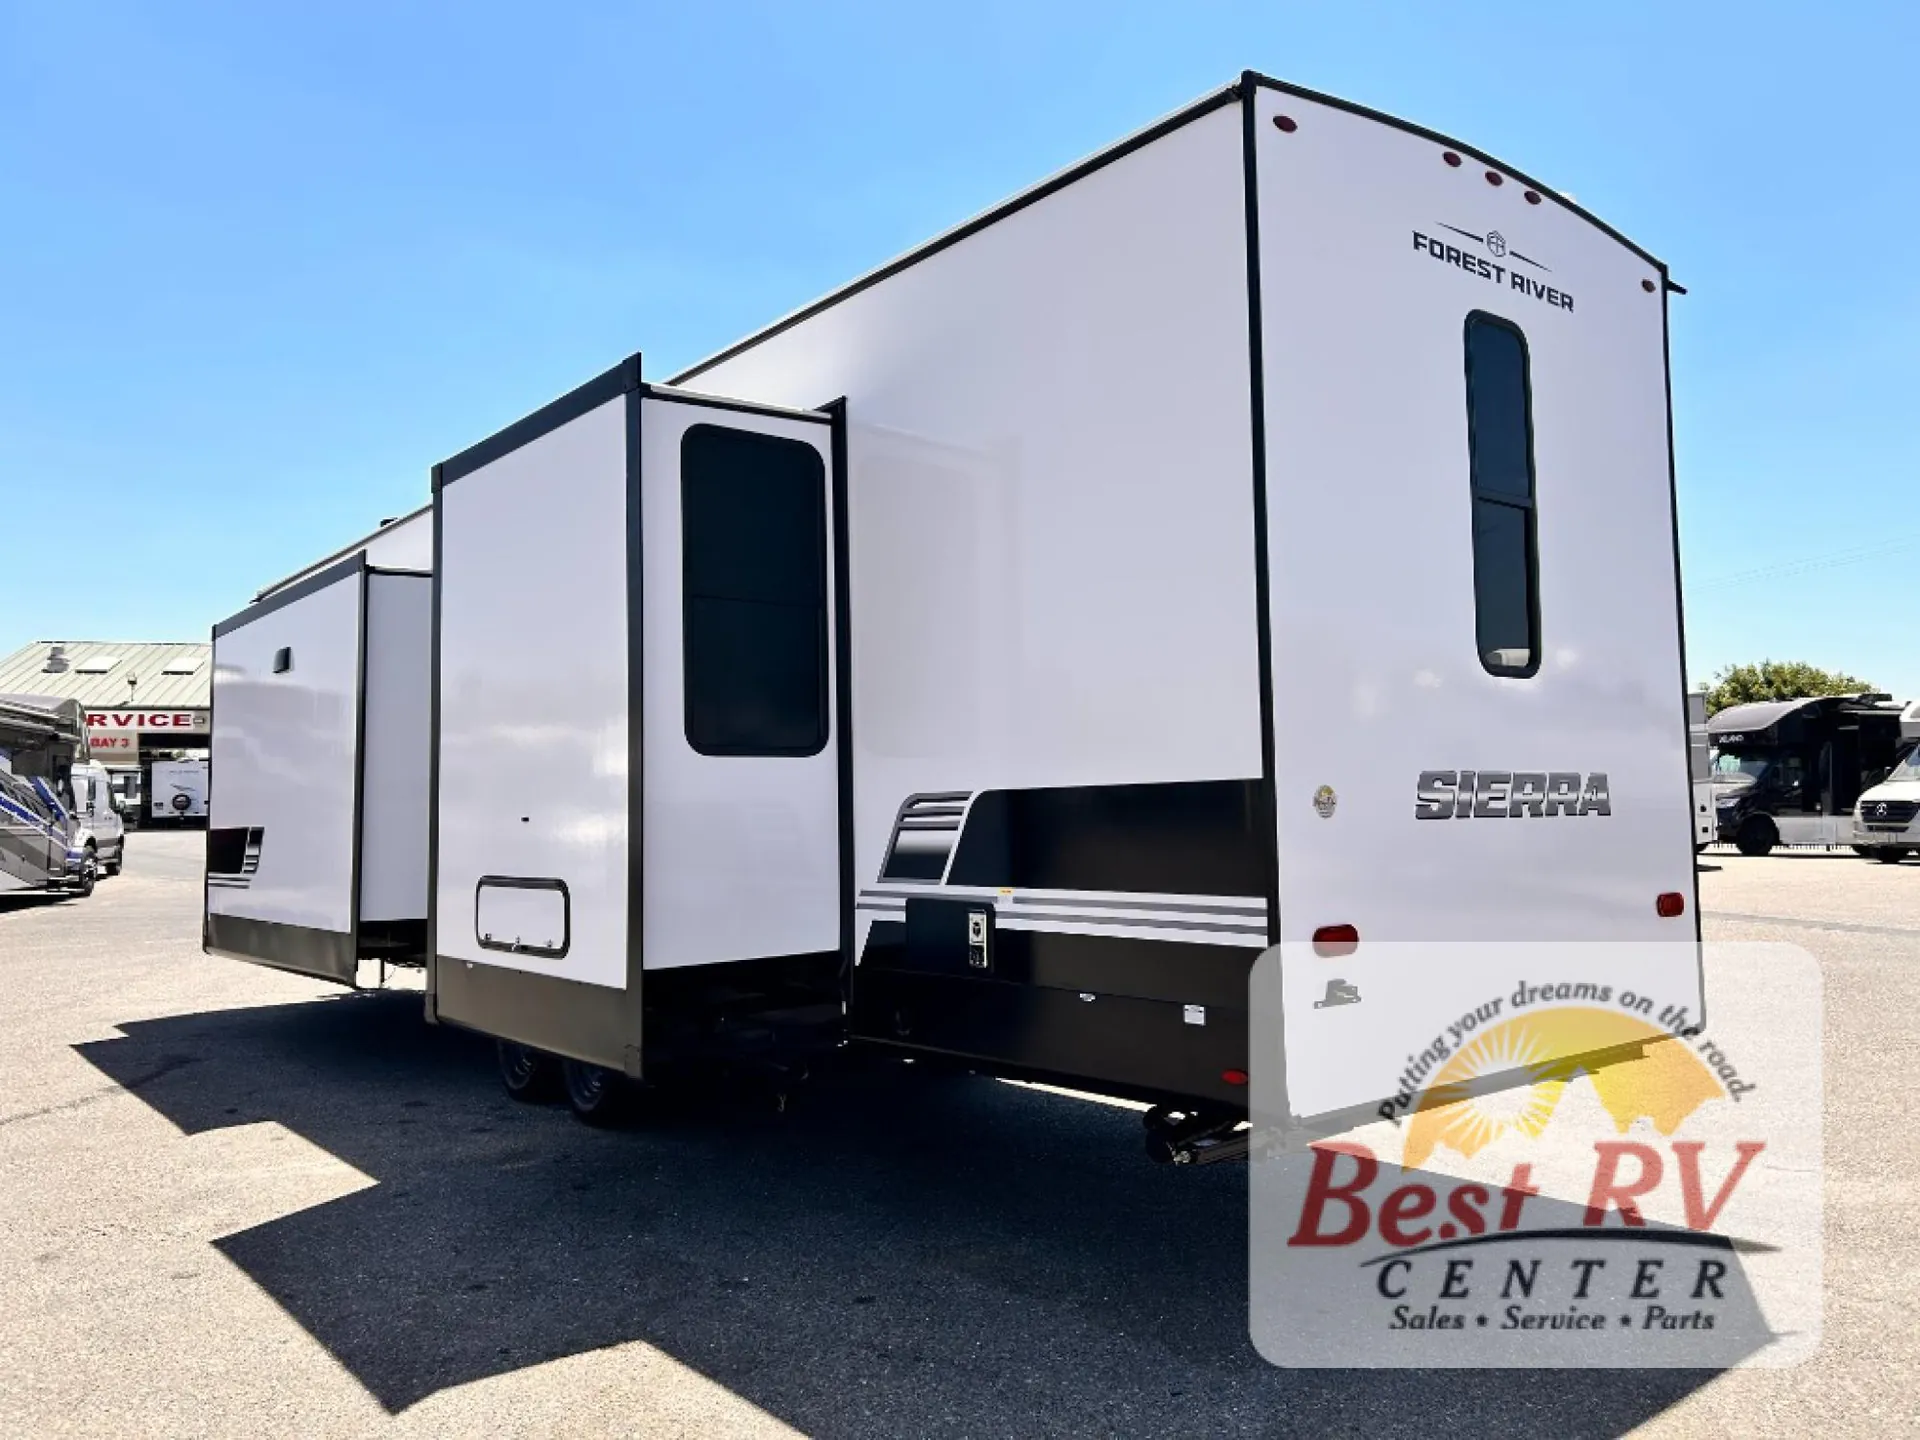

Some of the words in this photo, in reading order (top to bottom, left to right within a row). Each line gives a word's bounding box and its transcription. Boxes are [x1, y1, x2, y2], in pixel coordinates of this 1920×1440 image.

[1412, 230, 1505, 283] FOREST
[1511, 271, 1574, 313] RIVER
[85, 714, 192, 726] RVICE
[90, 738, 117, 748] BAY
[1415, 770, 1612, 820] SIERRA
